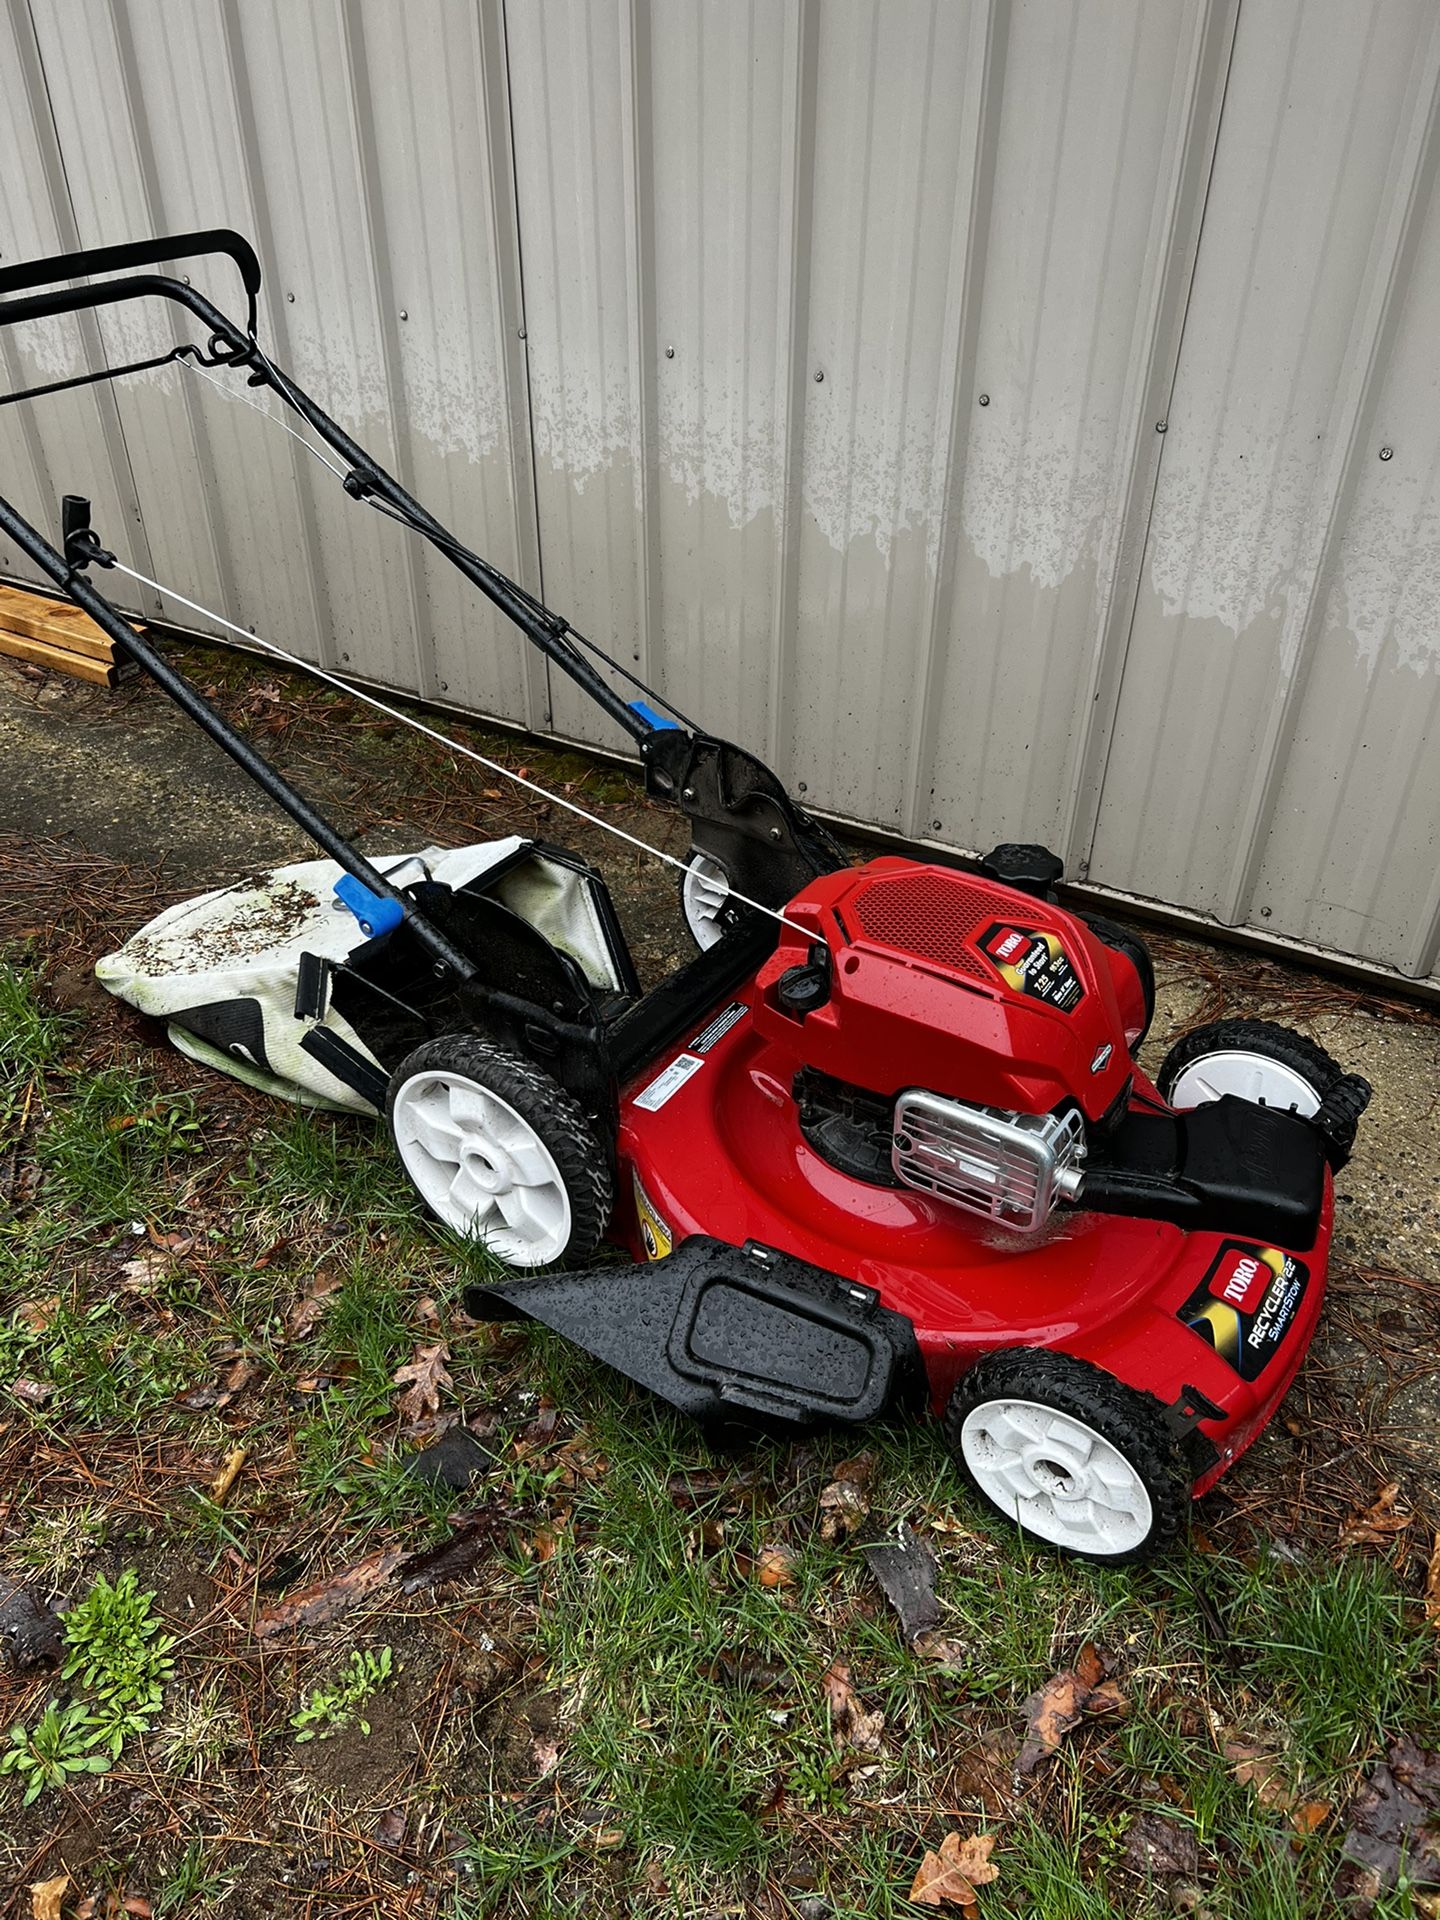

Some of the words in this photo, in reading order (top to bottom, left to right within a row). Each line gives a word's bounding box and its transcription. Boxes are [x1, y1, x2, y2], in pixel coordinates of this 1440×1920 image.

[995, 933, 1022, 958] TORO
[1015, 941, 1045, 975] Guaranteed
[1033, 953, 1048, 970] Start
[1034, 974, 1049, 991] 7.25
[1223, 1258, 1257, 1303] TORO
[1247, 1276, 1289, 1349] RECYCLER
